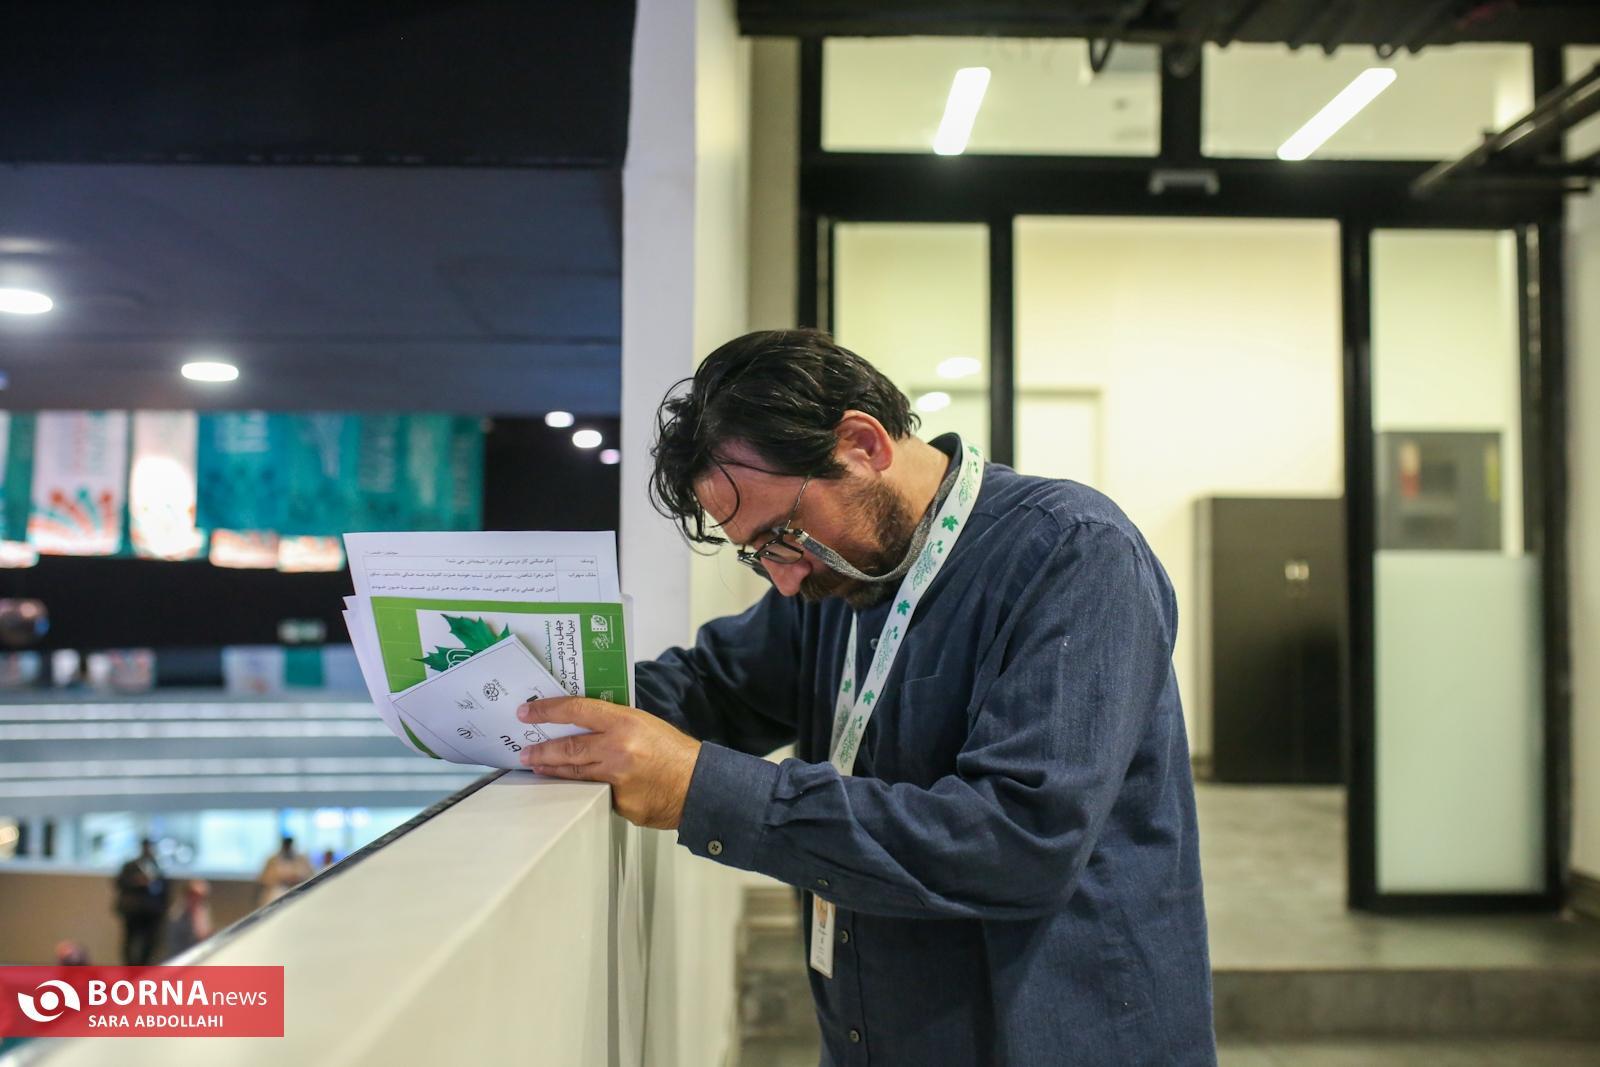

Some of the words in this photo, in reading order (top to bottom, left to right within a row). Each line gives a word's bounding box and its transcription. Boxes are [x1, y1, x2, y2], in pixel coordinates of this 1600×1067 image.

[554, 620, 565, 640] چهل
[557, 646, 568, 679] دومین
[566, 656, 579, 680] فیلم
